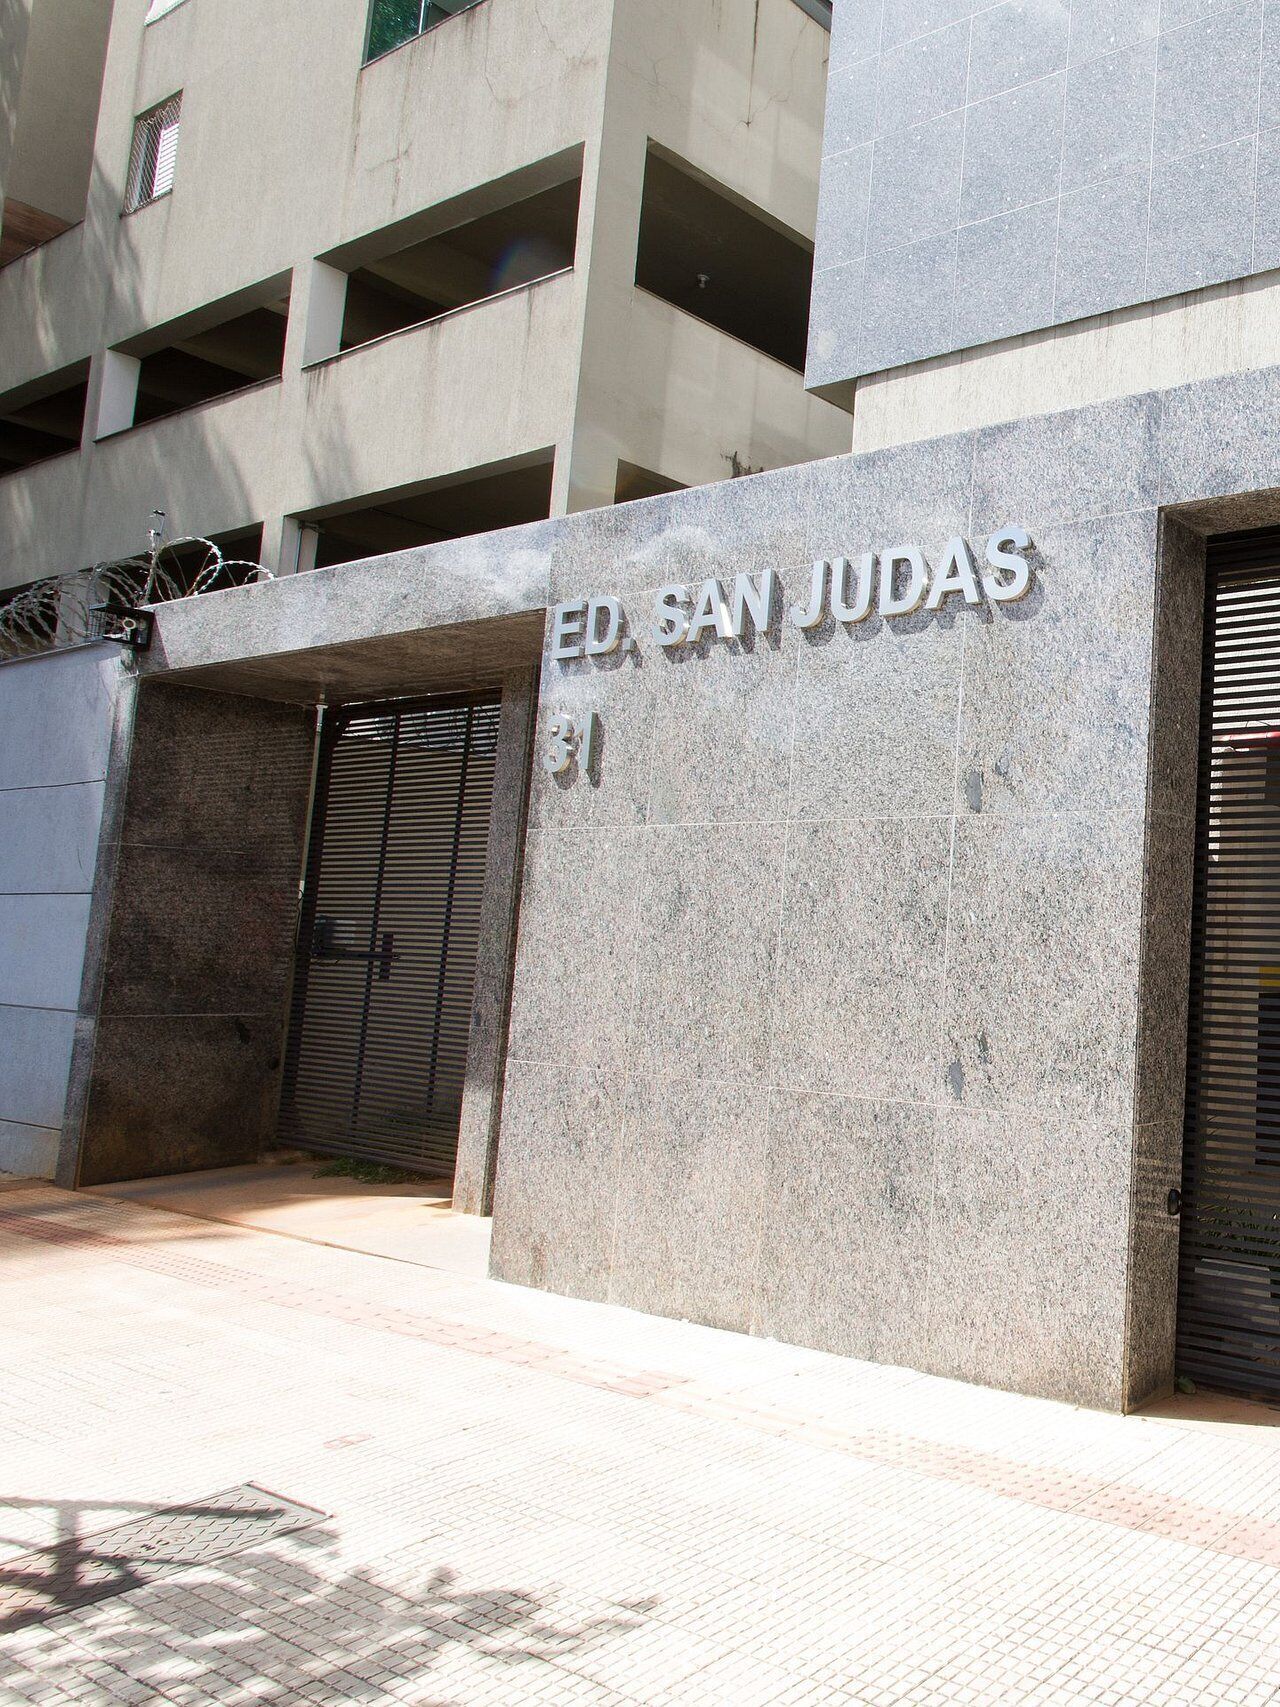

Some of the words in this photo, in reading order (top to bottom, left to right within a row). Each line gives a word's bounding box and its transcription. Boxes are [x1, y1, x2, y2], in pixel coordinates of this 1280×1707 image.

[553, 595, 635, 660] ED.
[653, 569, 776, 646] SAN
[790, 526, 1035, 628] JUDAS
[543, 711, 599, 774] 31
